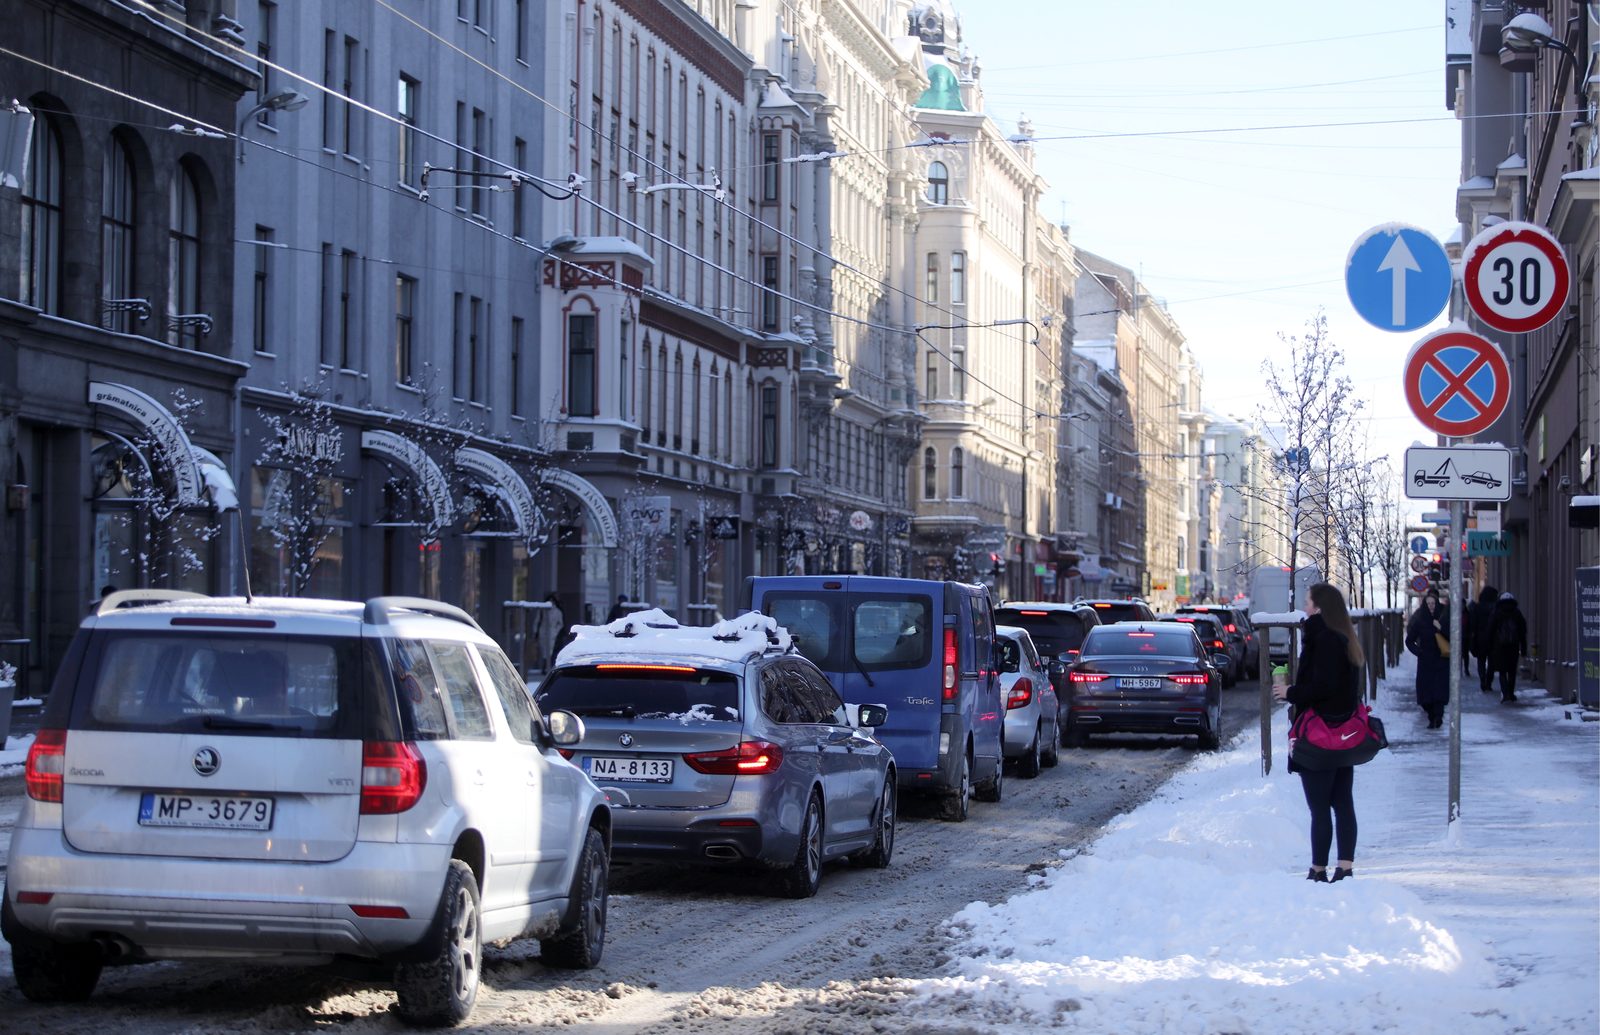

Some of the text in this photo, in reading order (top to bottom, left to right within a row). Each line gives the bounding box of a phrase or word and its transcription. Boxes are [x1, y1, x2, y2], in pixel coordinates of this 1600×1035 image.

[1493, 257, 1540, 306] 30
[96, 393, 146, 417] grāmatnica
[1121, 679, 1160, 688] MH-5967
[906, 696, 935, 705] Trafic
[595, 760, 669, 777] NA-8133
[158, 797, 268, 822] MP-3679
